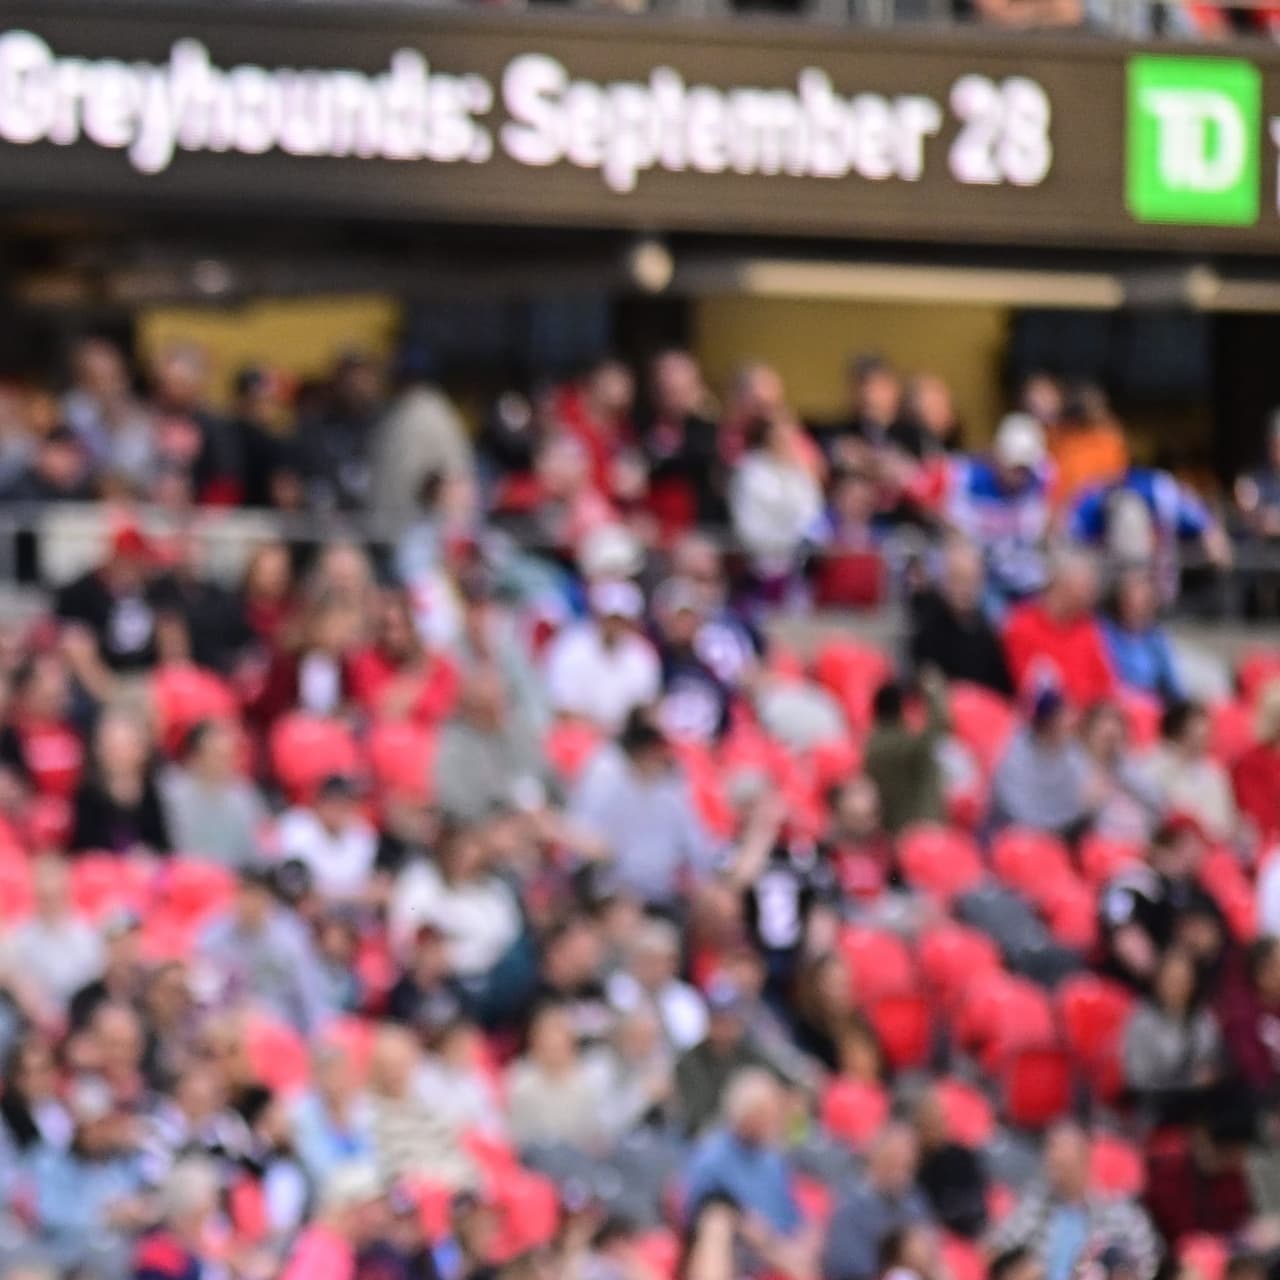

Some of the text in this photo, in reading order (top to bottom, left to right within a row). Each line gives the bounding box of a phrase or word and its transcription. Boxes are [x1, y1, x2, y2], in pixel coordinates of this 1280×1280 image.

[501, 53, 941, 193] September
[949, 74, 1052, 187] 28
[1146, 89, 1248, 192] TD
